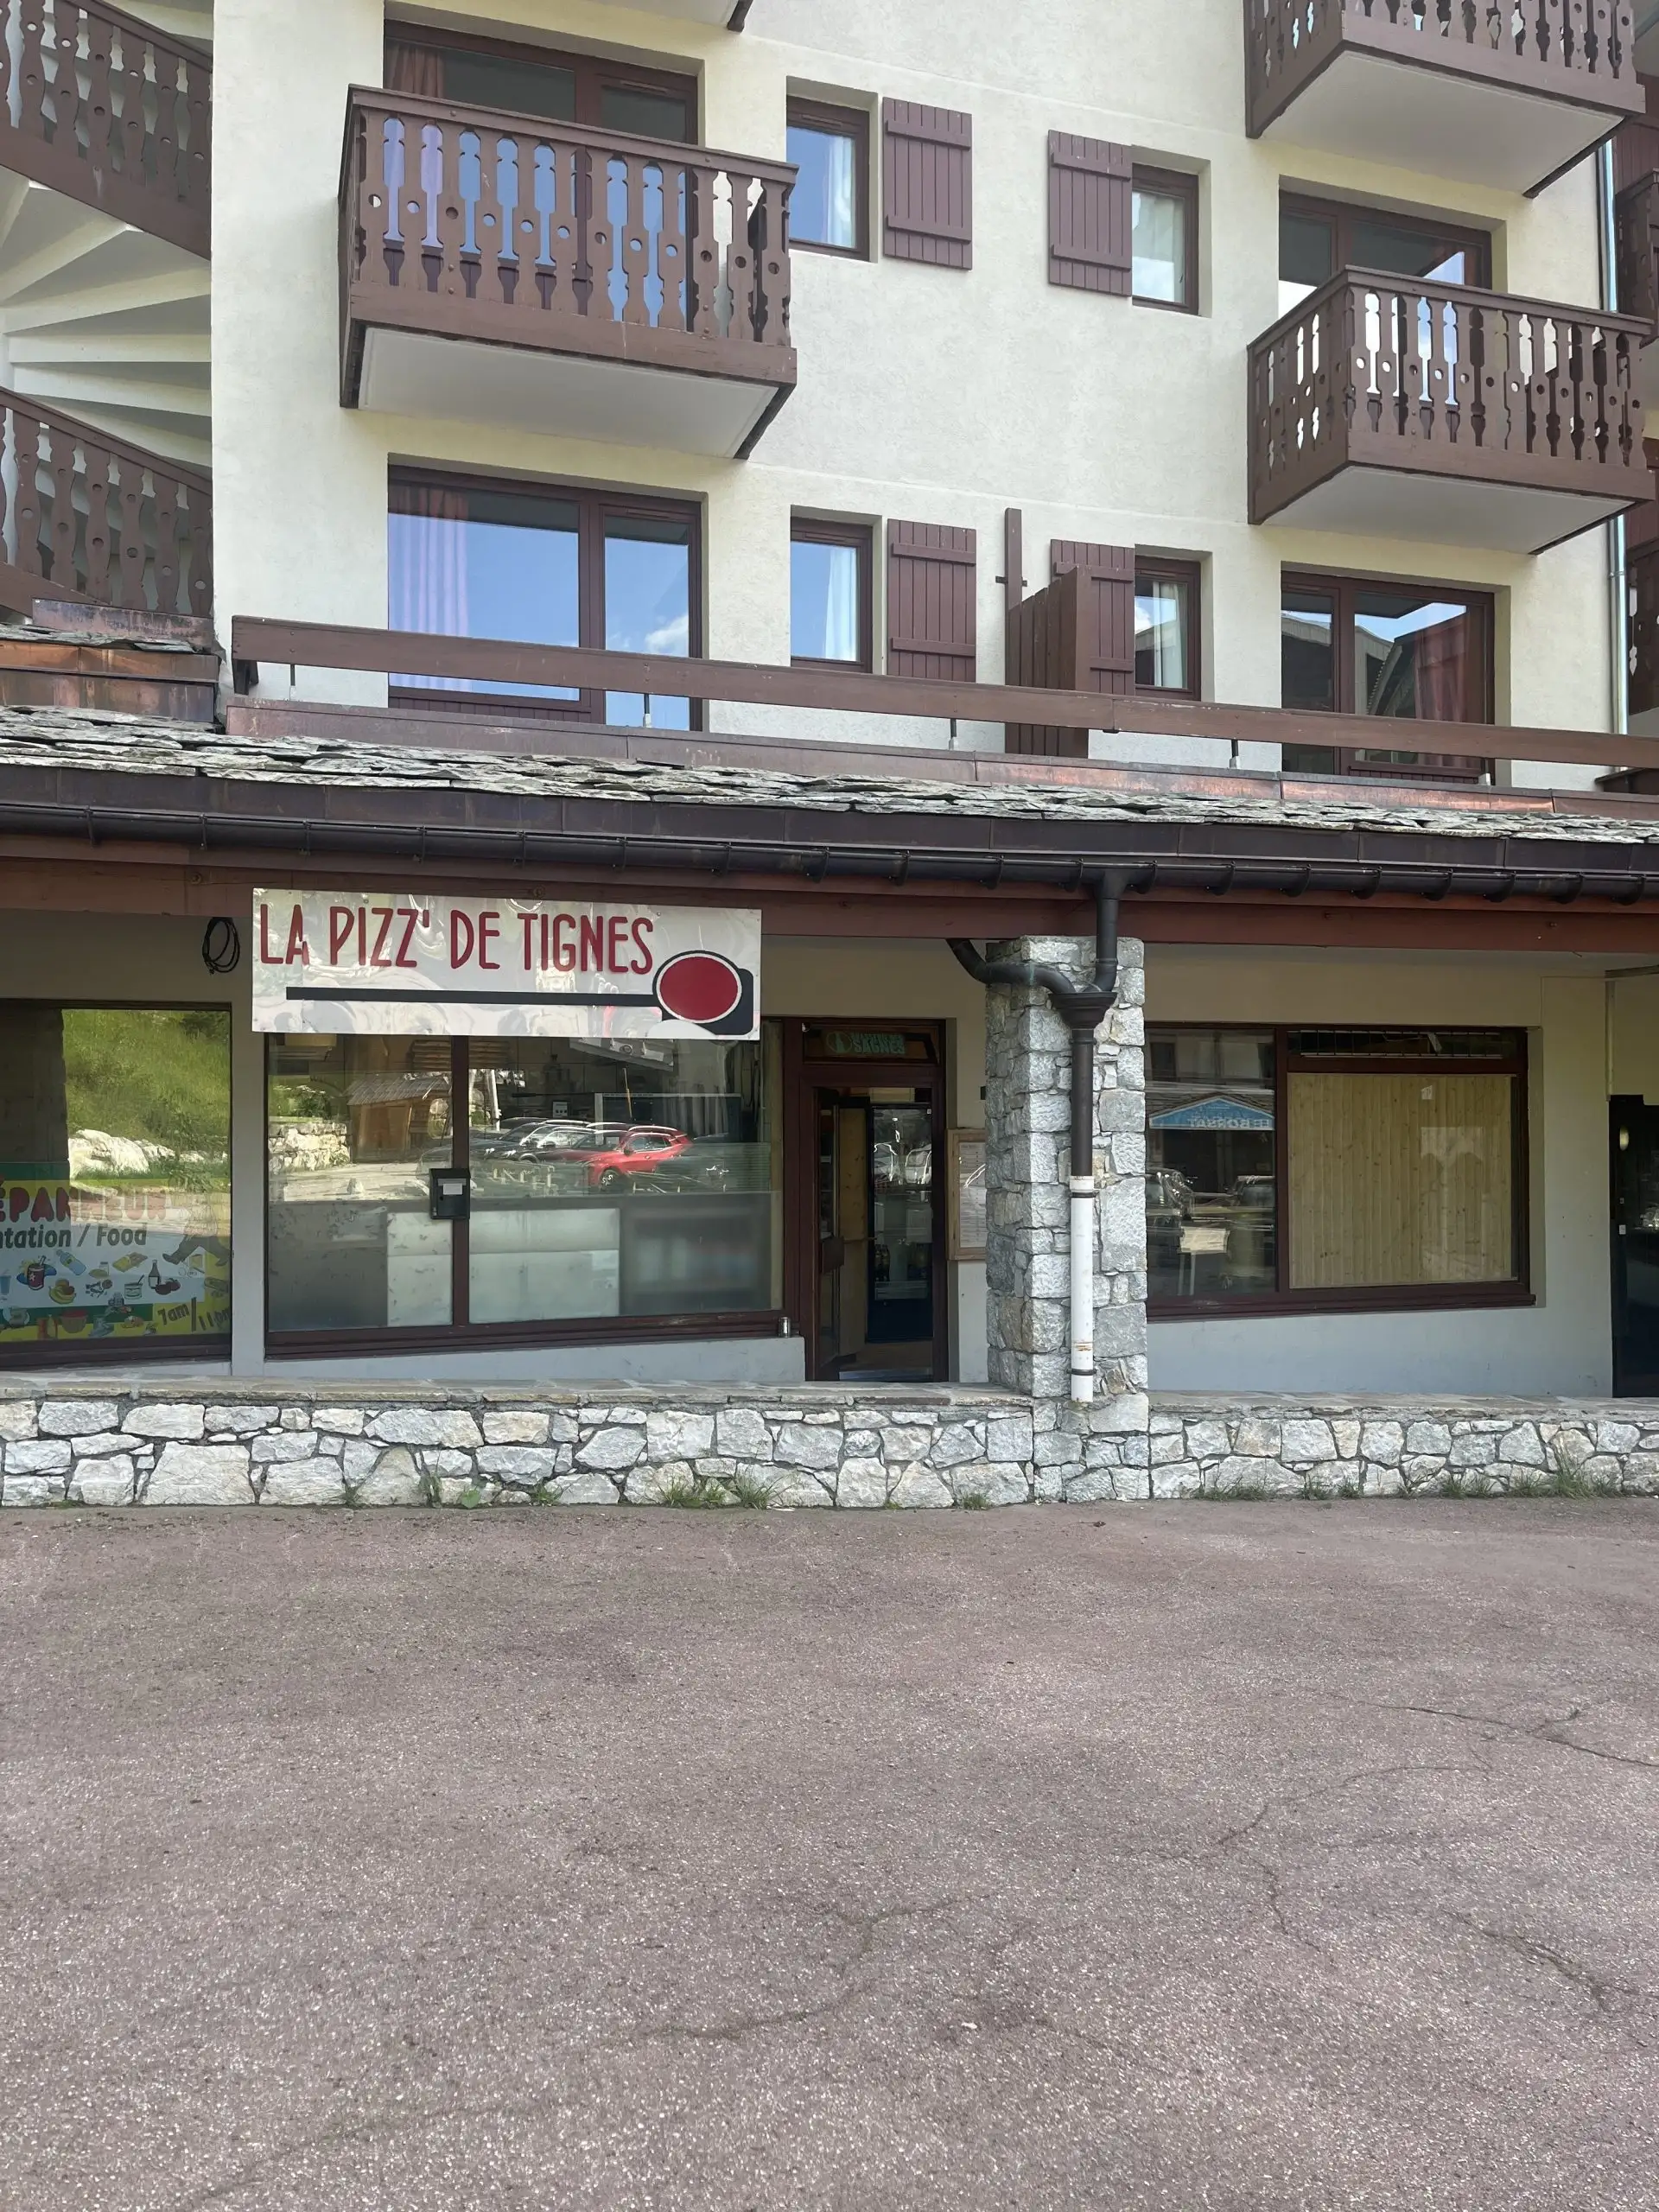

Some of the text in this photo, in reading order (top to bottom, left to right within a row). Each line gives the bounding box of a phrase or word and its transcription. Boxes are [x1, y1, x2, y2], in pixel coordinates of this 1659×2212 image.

[260, 904, 654, 975] LA PIZZ' DE TIGNES
[97, 1223, 147, 1247] Food
[157, 1303, 190, 1325] 7am
